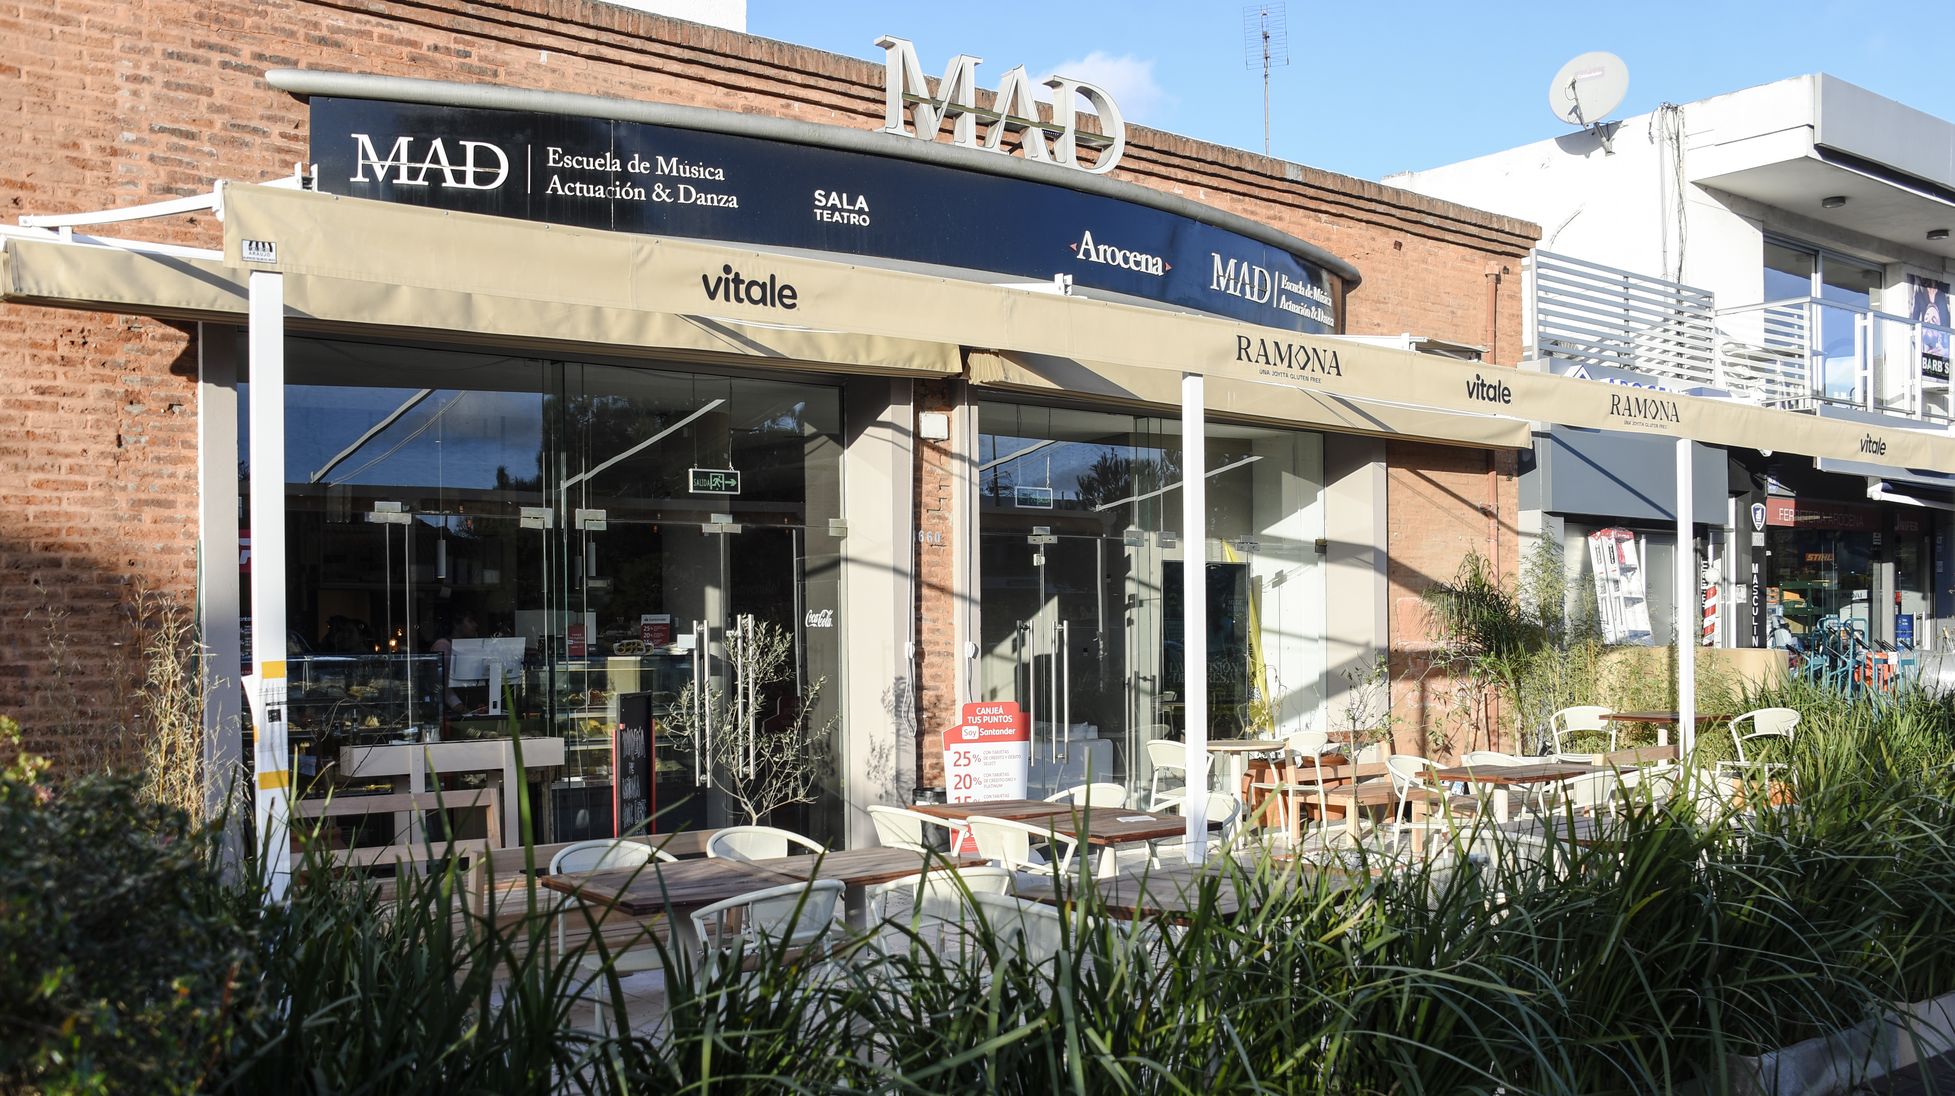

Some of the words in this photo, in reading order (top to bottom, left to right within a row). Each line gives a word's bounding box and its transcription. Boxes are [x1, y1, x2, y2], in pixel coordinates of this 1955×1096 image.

[874, 34, 1126, 174] MAD
[350, 134, 510, 190] MAD
[546, 147, 622, 172] Escuela
[627, 151, 650, 174] de
[655, 155, 725, 181] Música
[545, 175, 646, 201] Actuación
[653, 183, 674, 203] &
[677, 184, 739, 209] Danza
[814, 190, 870, 212] SALA
[813, 209, 870, 227] TEATRO
[1076, 230, 1164, 276] Arocena
[702, 263, 799, 310] vitale
[1210, 252, 1272, 304] MAD
[1236, 334, 1343, 377] RAMONA
[1466, 373, 1512, 405] vitale
[1610, 393, 1680, 423] RAMONA
[1860, 433, 1886, 456] vitale
[693, 478, 711, 487] SALIDA
[963, 728, 977, 738] Soy
[979, 727, 1016, 737] Santander
[968, 716, 981, 724] TUS
[983, 714, 1013, 723] PUNTOS
[953, 751, 982, 767] 25%
[953, 774, 983, 790] 20%
